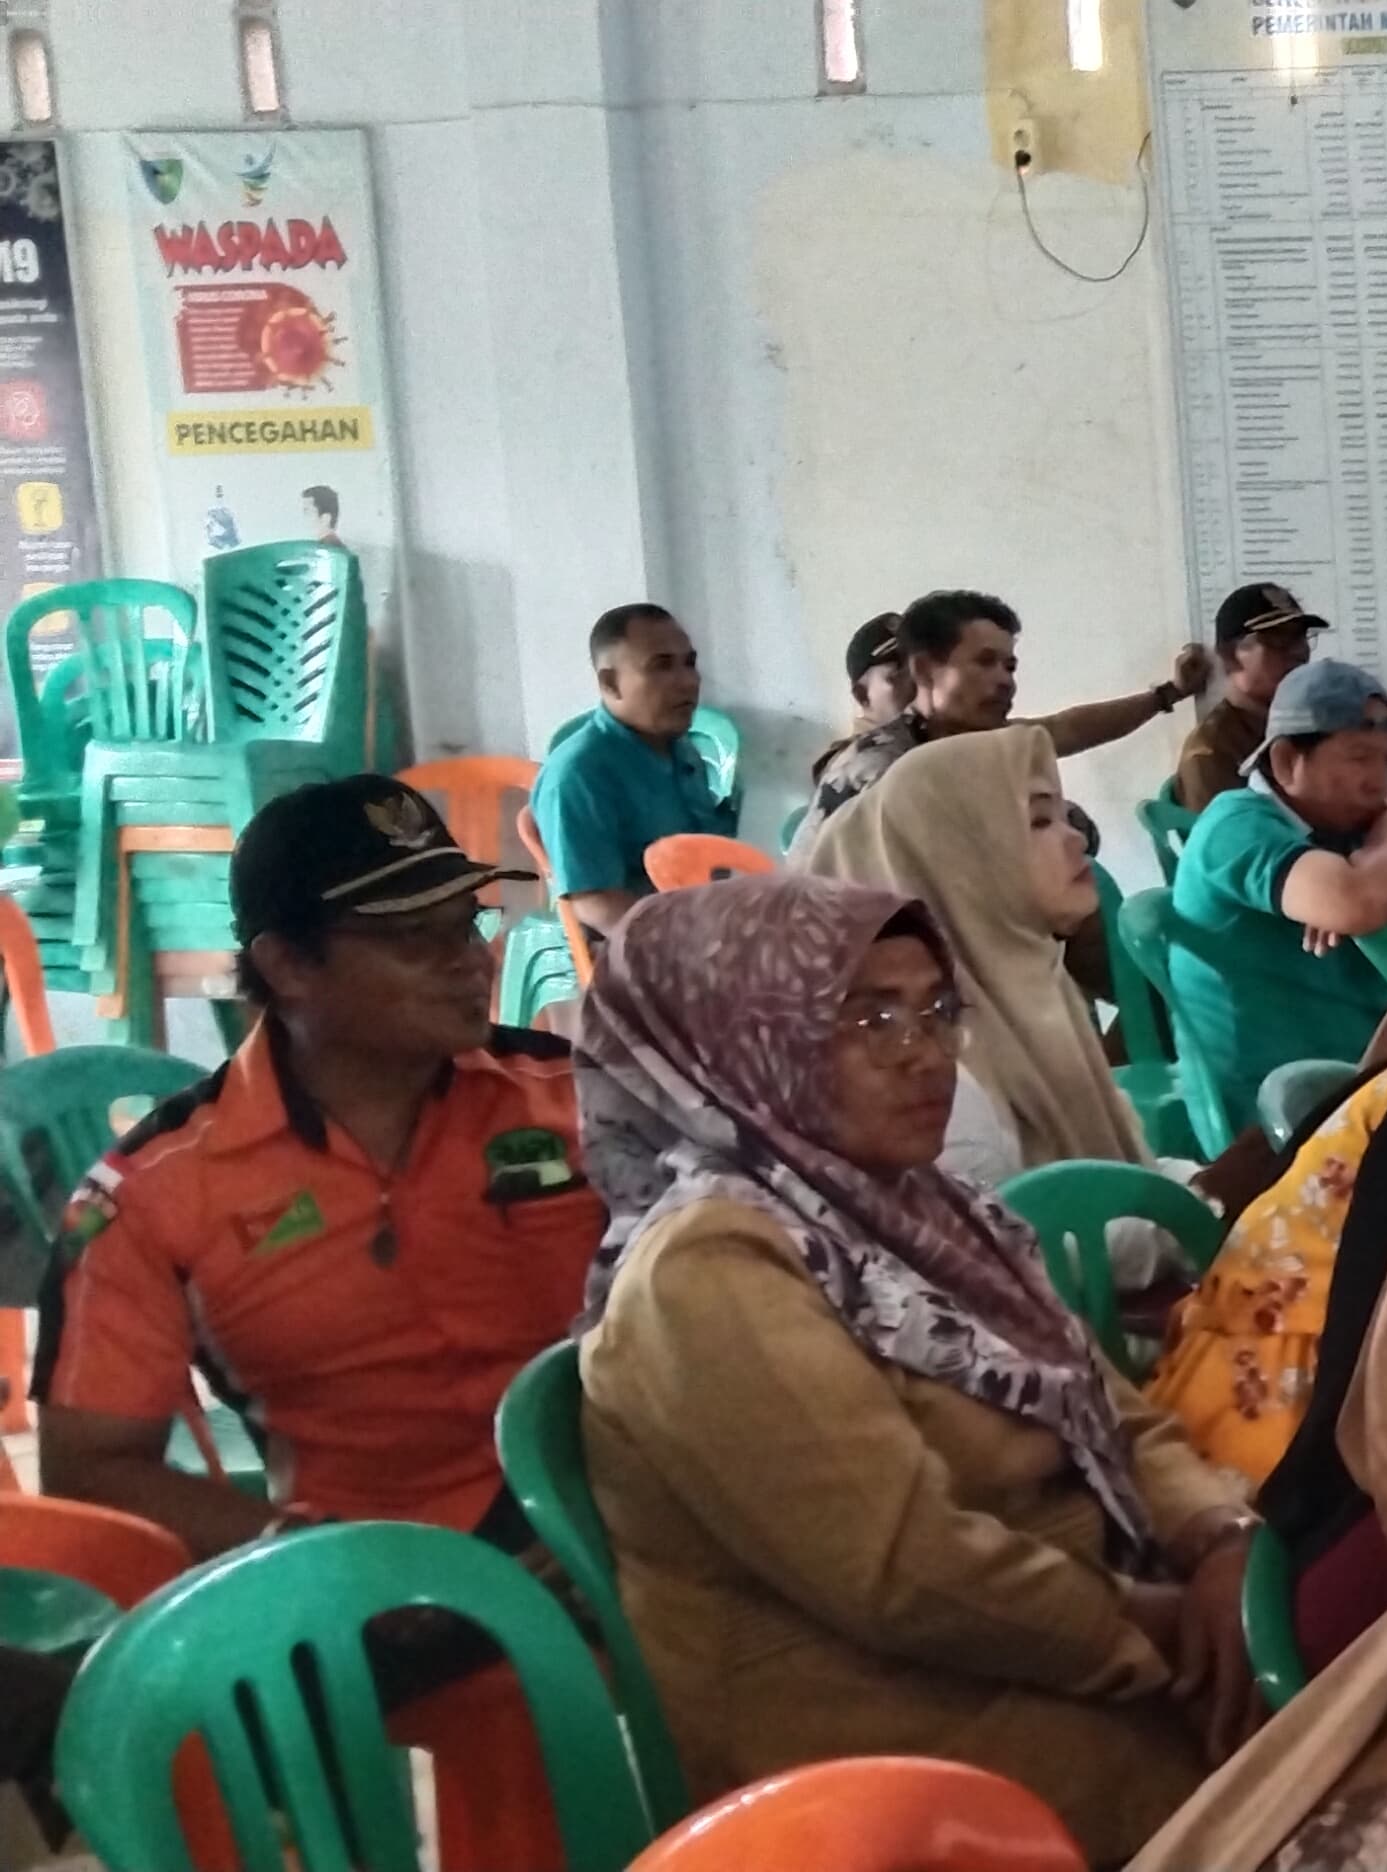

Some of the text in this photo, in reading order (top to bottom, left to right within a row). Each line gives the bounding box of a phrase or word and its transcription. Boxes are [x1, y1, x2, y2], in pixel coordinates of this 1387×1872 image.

[1251, 12, 1373, 35] PEMERINTAH
[153, 215, 348, 278] WASPADA
[175, 418, 361, 446] PENCEGAHAN
